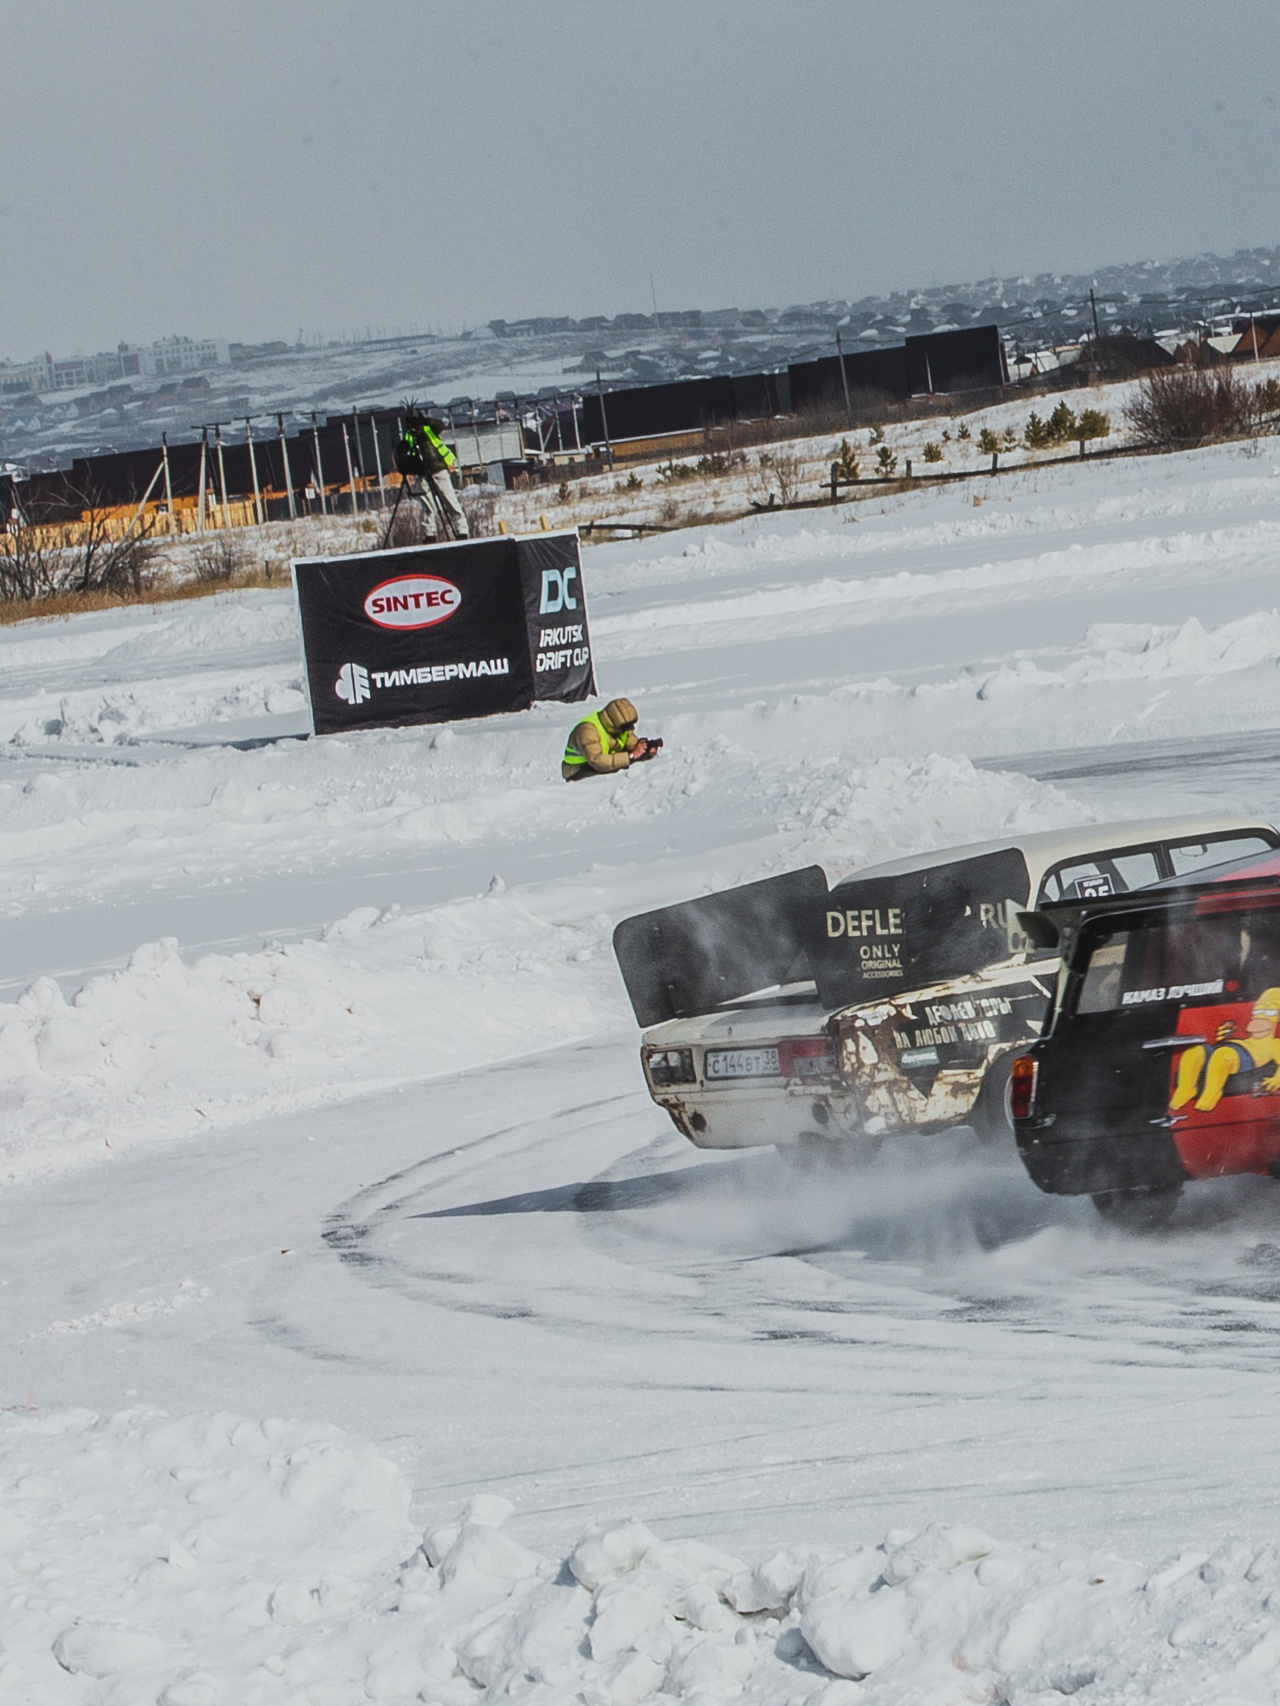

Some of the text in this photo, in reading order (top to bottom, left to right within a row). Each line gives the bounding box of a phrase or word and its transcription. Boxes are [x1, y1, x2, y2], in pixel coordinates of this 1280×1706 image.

[371, 589, 454, 614] SINTEC
[539, 566, 577, 614] DC
[539, 624, 583, 648] IRKUTSK
[536, 646, 589, 673] DRIFT CUP
[371, 657, 509, 689] ТИМБЕРМАШ
[826, 908, 905, 938] DEFLE
[859, 944, 901, 959] ONLY
[861, 958, 903, 970] ORIGINAL
[862, 970, 904, 979] ACCESSORIES
